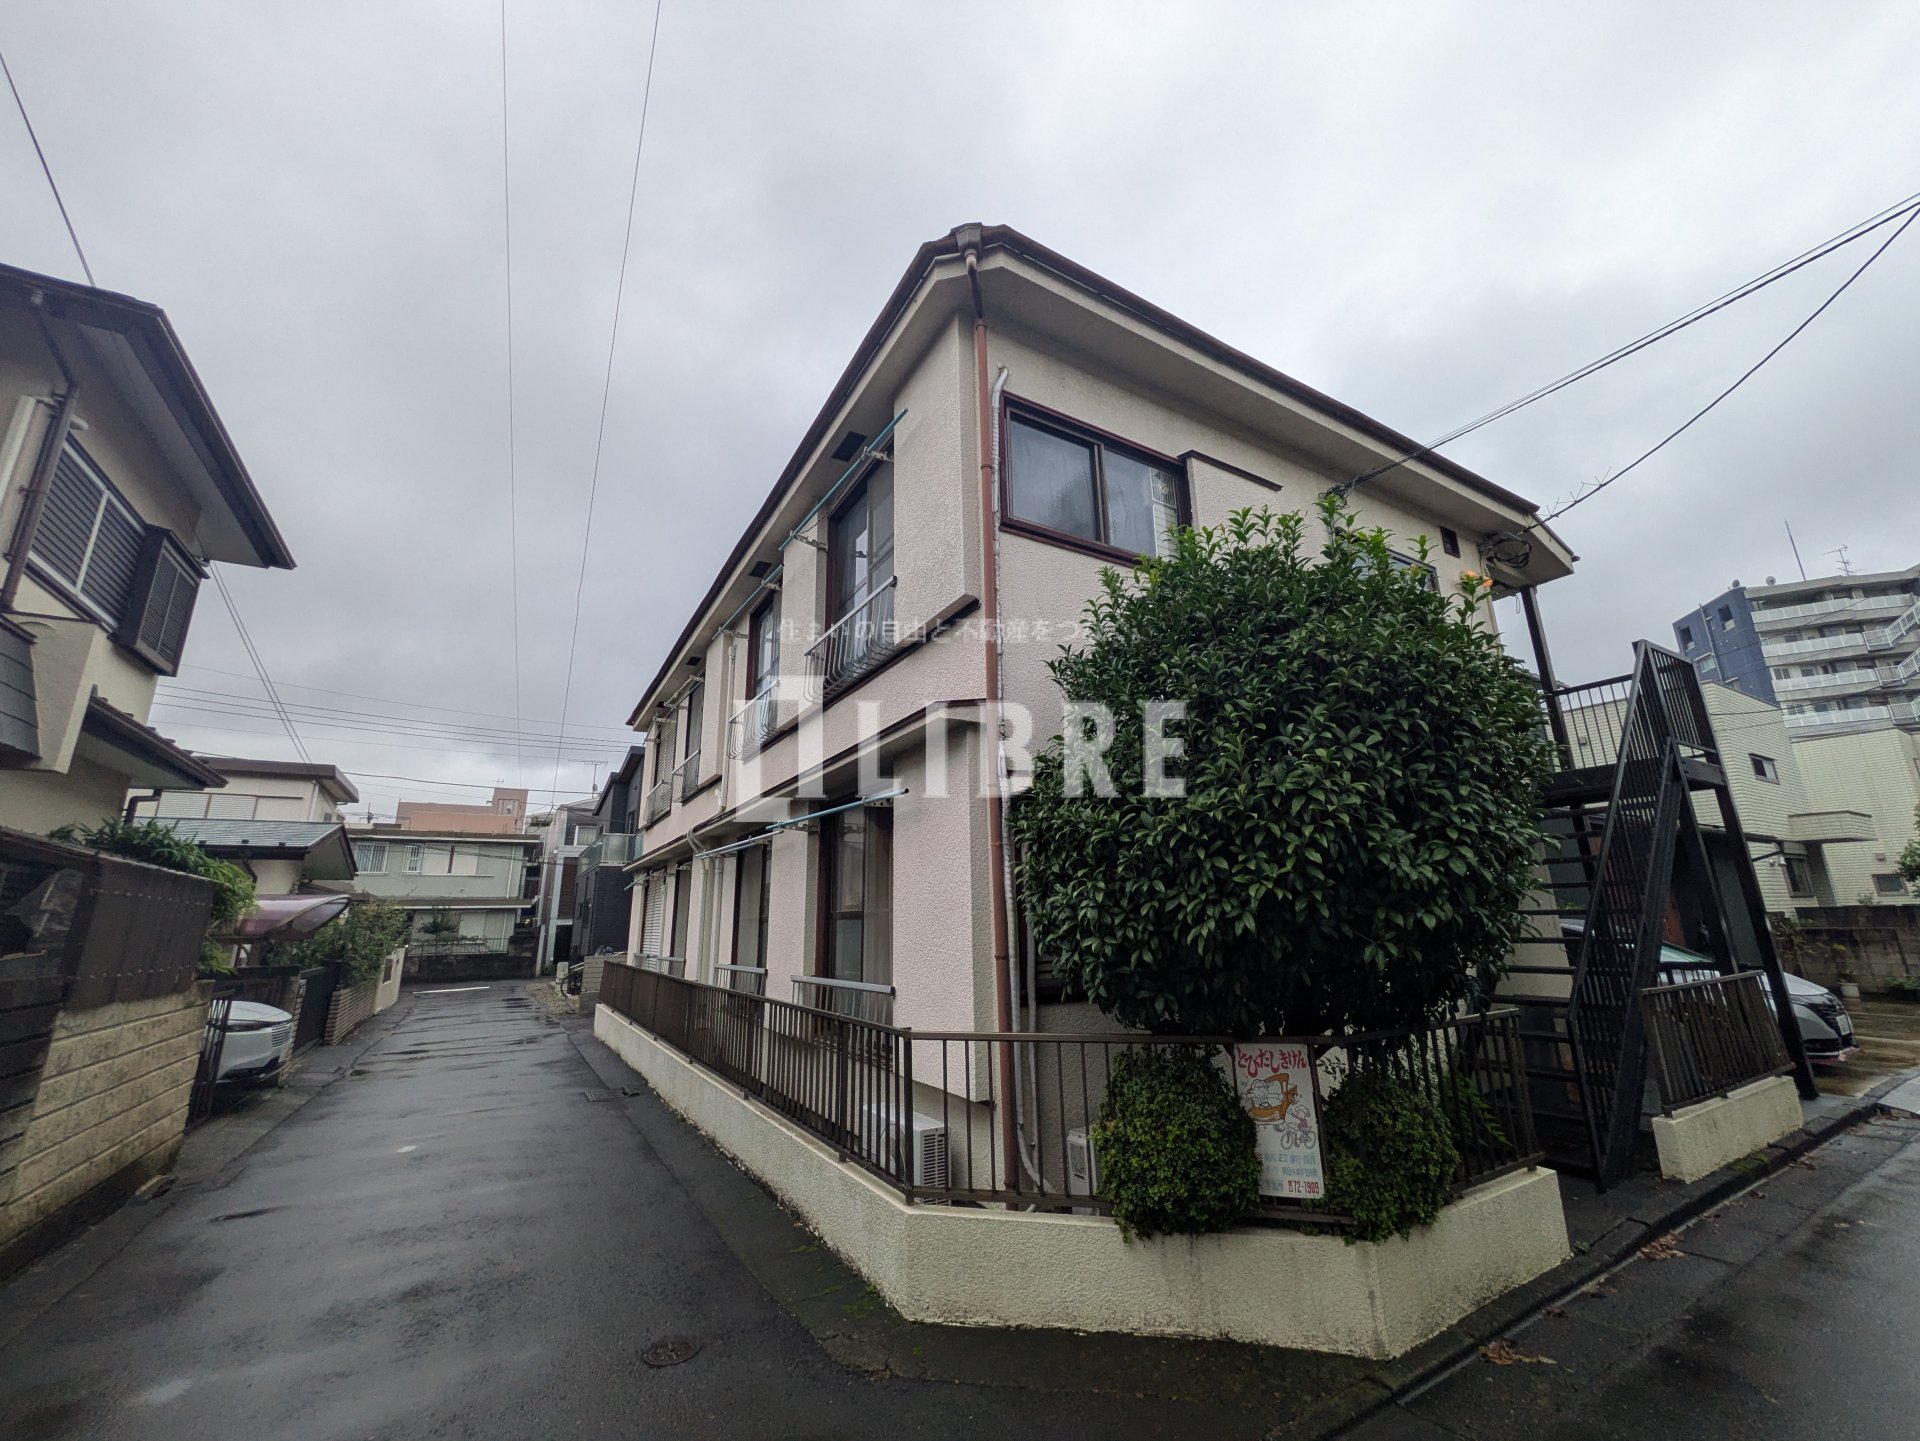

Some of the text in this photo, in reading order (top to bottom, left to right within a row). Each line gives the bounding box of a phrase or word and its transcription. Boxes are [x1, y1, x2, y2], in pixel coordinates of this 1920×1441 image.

[1237, 1046, 1307, 1078] とびだしきけん
